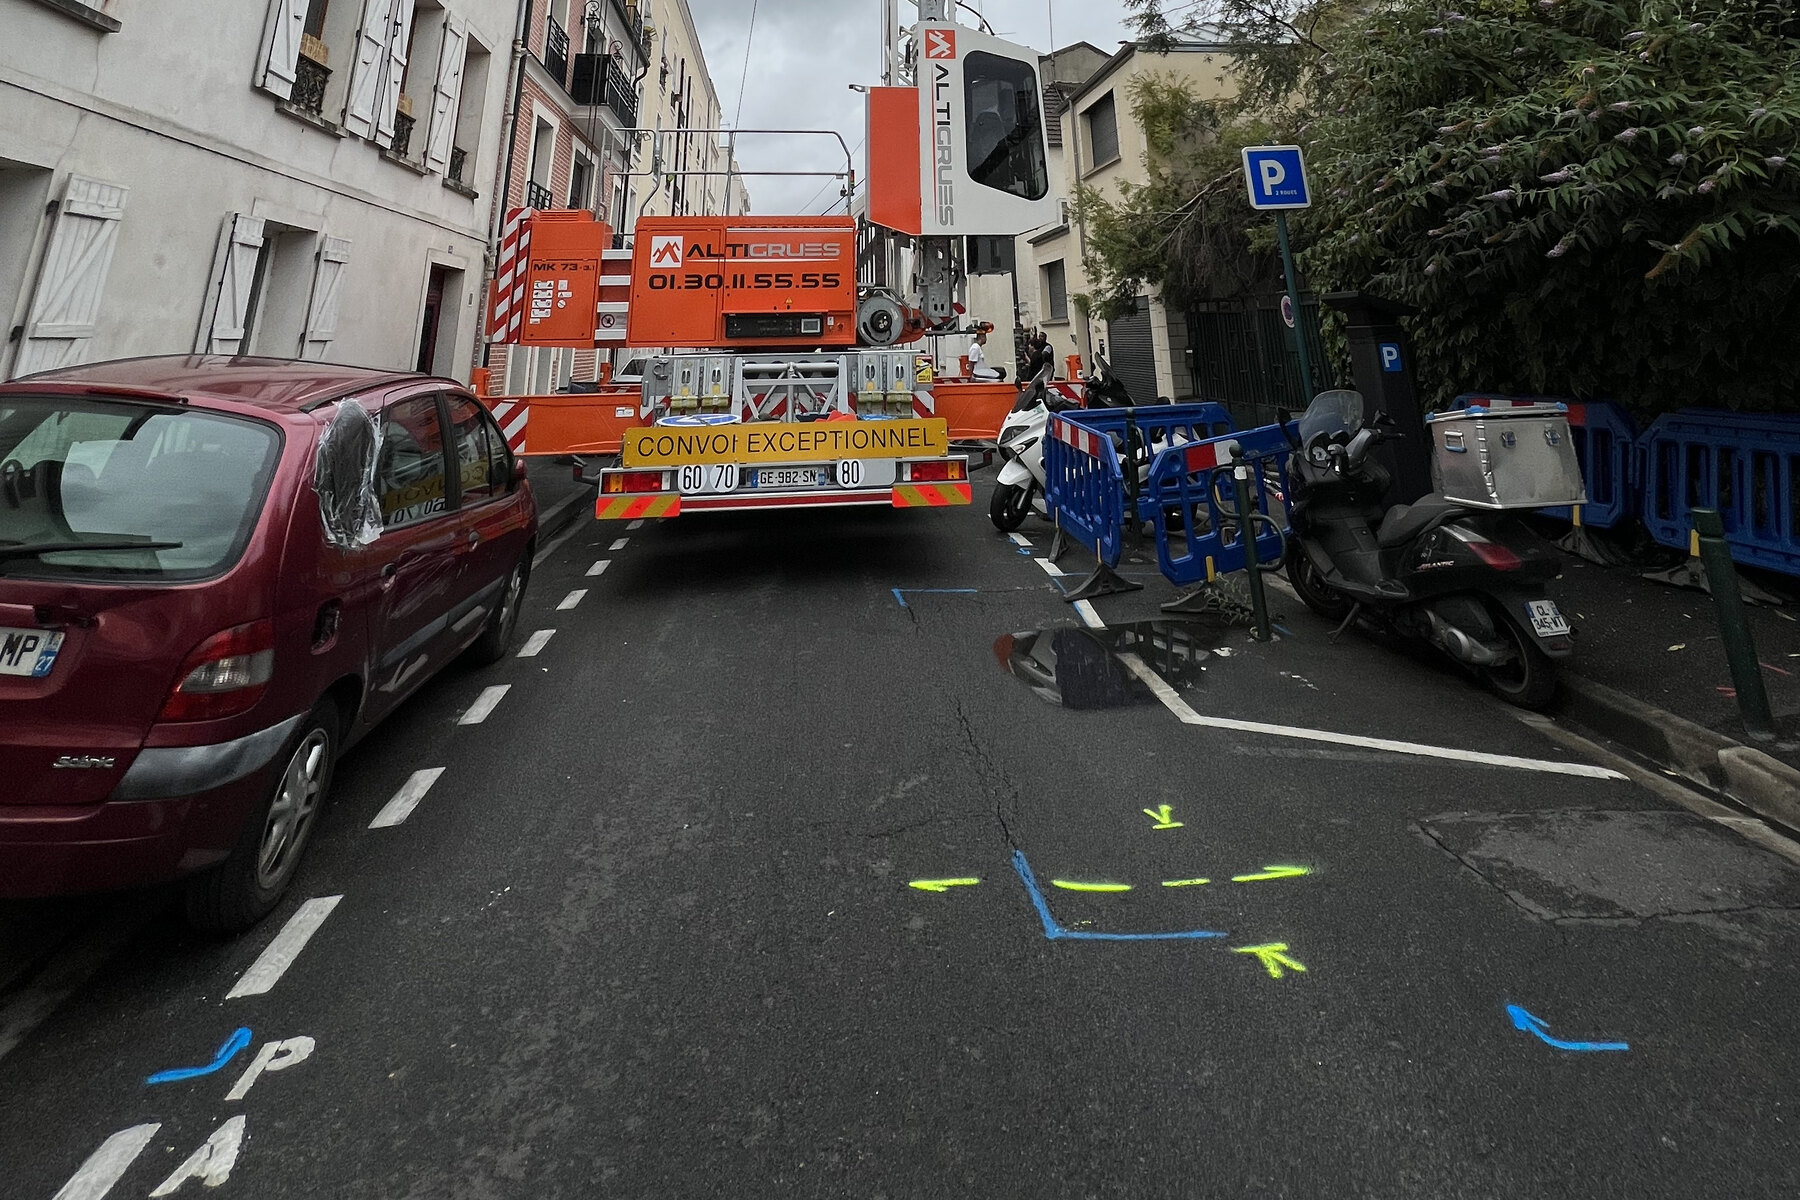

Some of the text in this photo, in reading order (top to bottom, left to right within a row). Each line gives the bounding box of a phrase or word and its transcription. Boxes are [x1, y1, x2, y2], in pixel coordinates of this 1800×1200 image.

[935, 63, 954, 226] ALTIGRUES
[1259, 160, 1285, 195] P
[686, 243, 840, 257] ALTIGRUES
[649, 273, 840, 290] 01.30.11.55.55
[1382, 347, 1397, 367] P
[638, 428, 935, 457] CONVOI EXCEPTIONNEL
[683, 465, 701, 490] 60
[715, 465, 734, 488] 70
[760, 470, 816, 484] GE-982-SN
[842, 460, 859, 485] 80
[35, 655, 55, 671] 27
